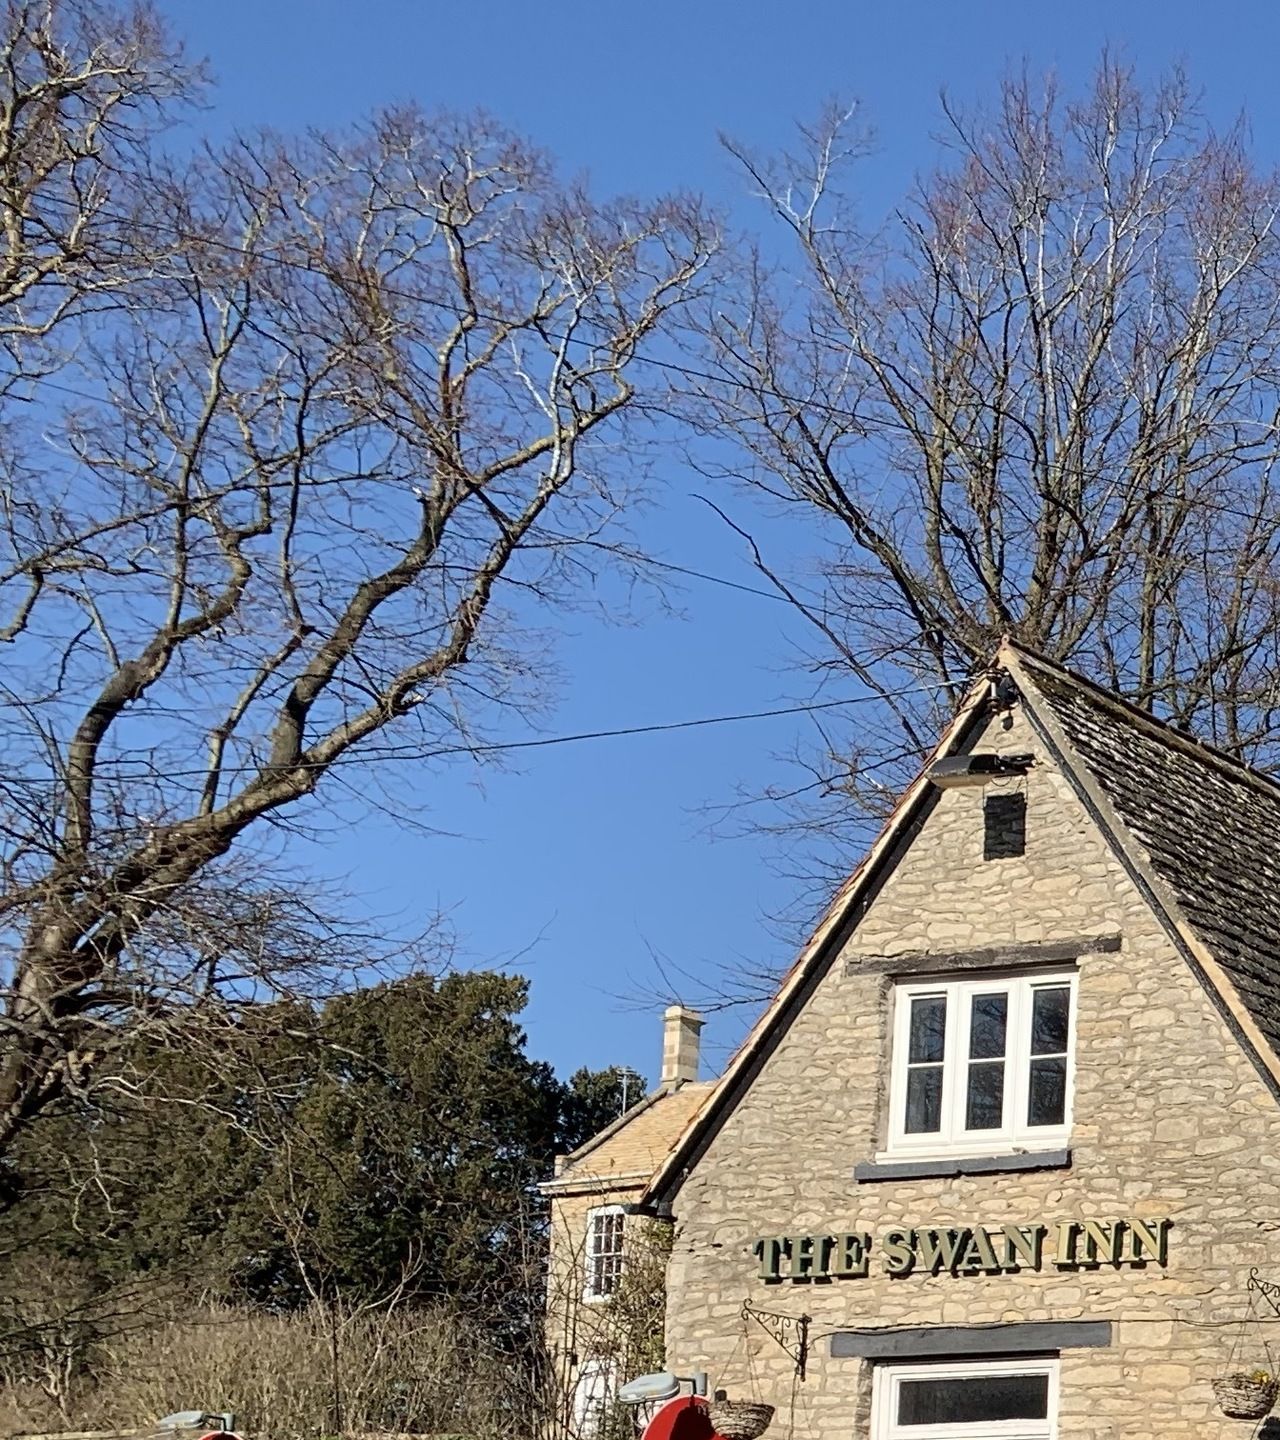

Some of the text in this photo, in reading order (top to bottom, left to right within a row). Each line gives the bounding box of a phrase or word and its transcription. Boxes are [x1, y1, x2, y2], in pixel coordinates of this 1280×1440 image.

[753, 1218, 1170, 1281] THE SWAN INN
